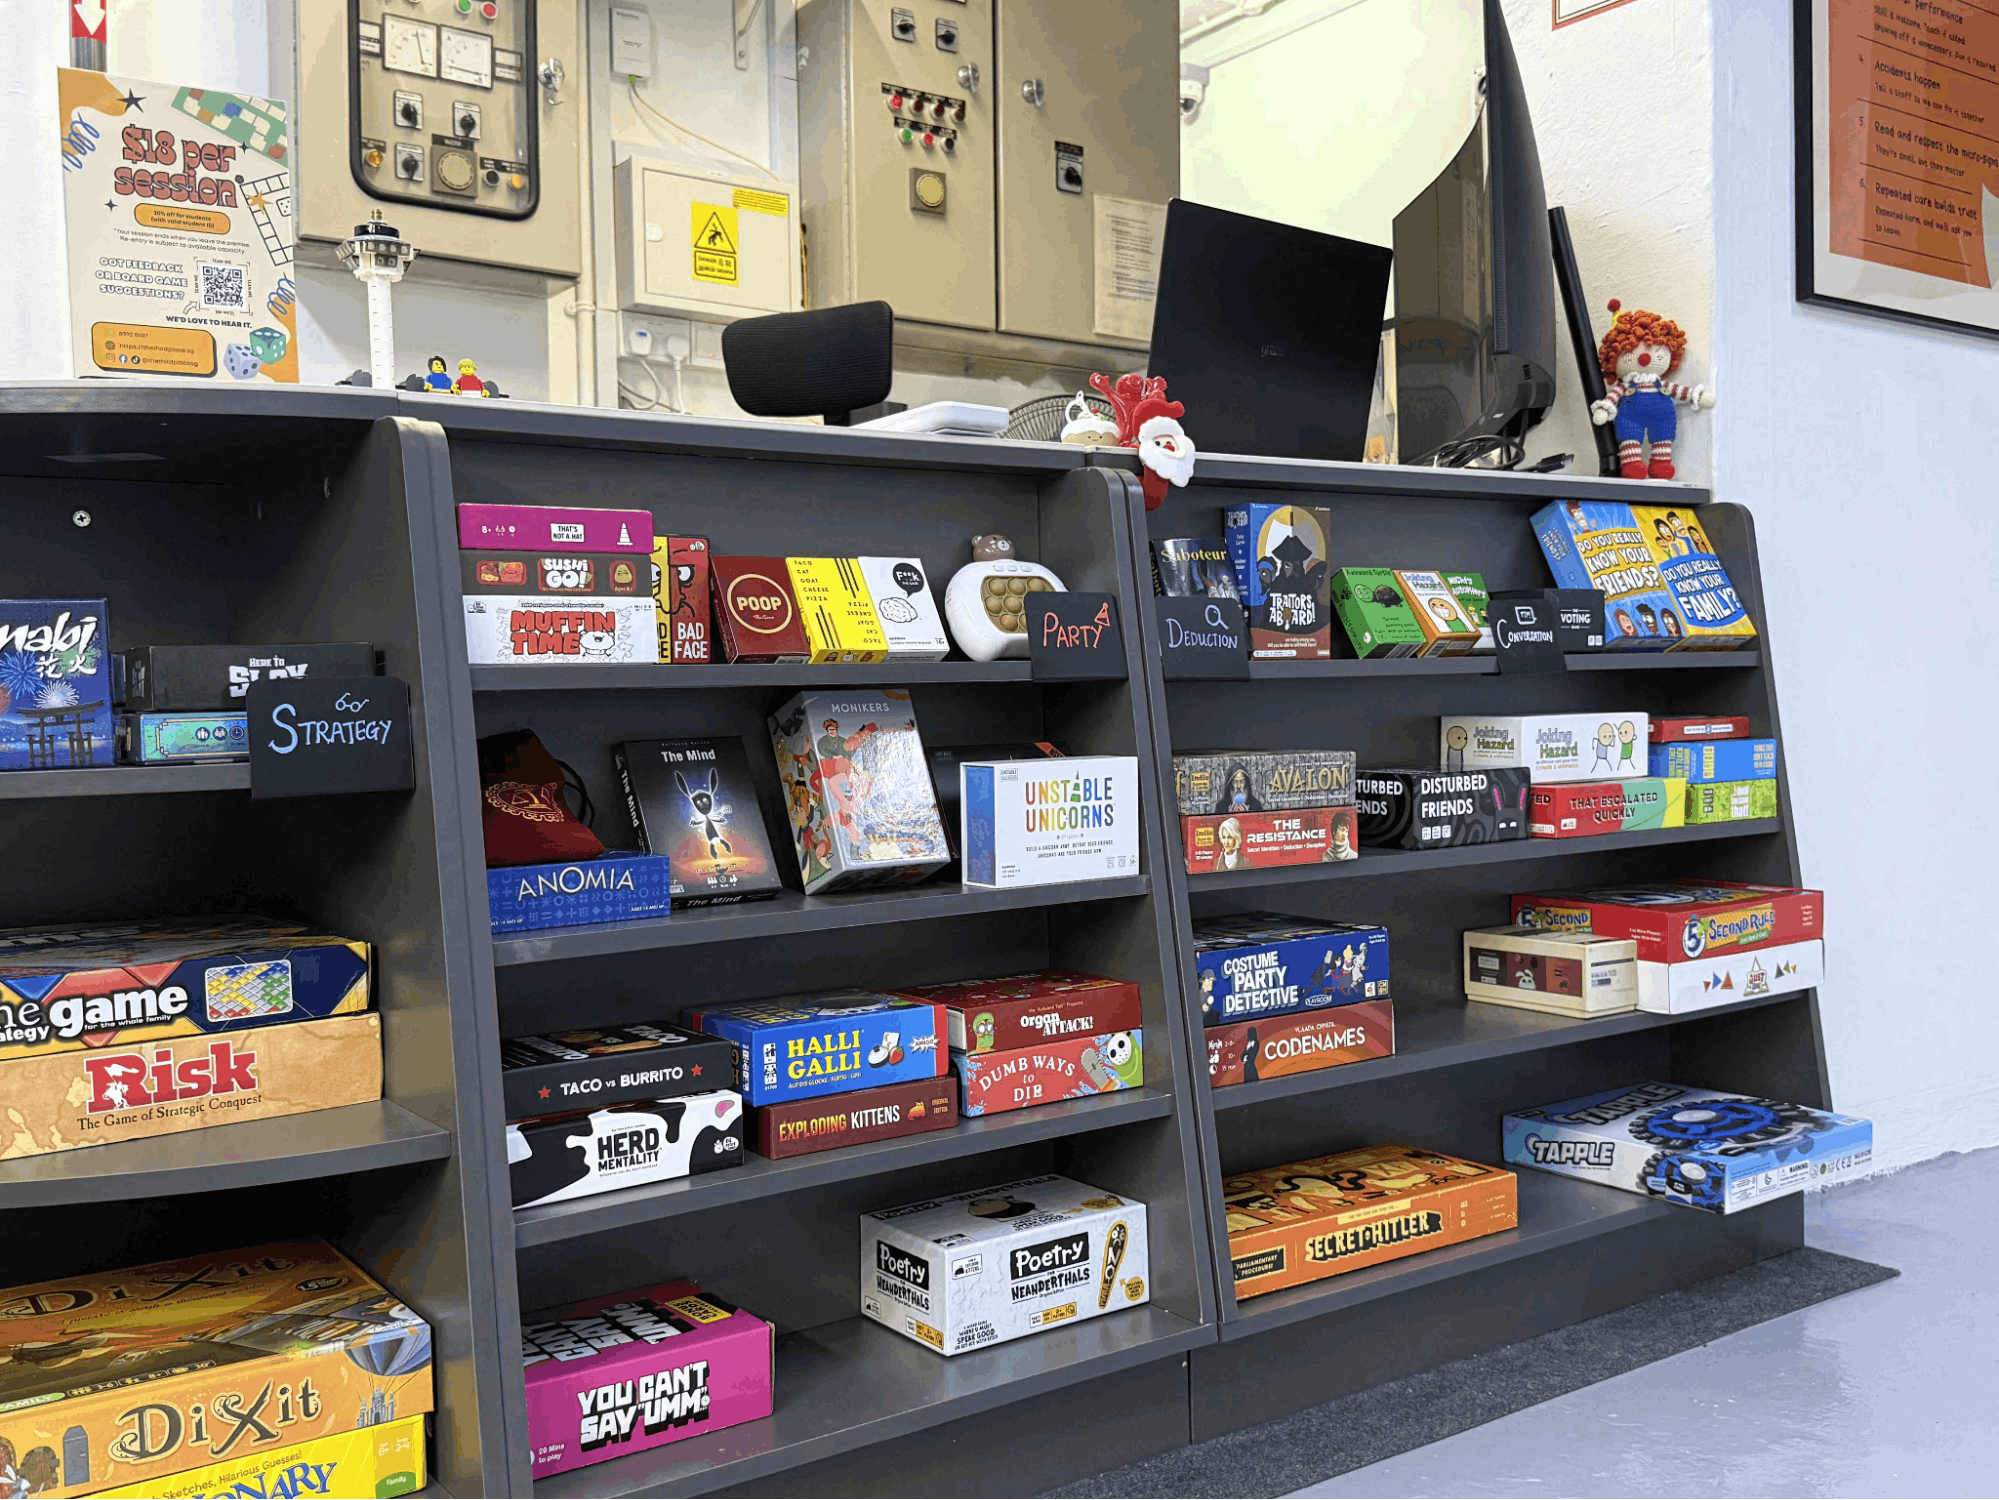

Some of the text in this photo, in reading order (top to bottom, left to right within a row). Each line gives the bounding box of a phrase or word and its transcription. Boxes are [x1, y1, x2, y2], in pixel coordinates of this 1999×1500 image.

[1916, 0, 1964, 24] performance
[1875, 60, 1941, 90] Accidents happen
[122, 123, 236, 173] $18 per
[1875, 121, 1894, 138] Read
[1897, 131, 1912, 142] and
[1914, 135, 1943, 152] respect
[1947, 144, 1959, 156] the
[1876, 145, 1897, 158] They're
[1930, 159, 1943, 171] they
[1945, 164, 1965, 176] matter
[114, 166, 238, 208] session
[1876, 183, 1977, 220] Repeated care builds trust
[99, 257, 183, 273] GOT FEEDBACK
[95, 270, 188, 287] OR BOARD GAME
[100, 284, 185, 300] SUGGESTIONS?
[222, 320, 241, 328] HEAR
[558, 525, 578, 533] THAT'S
[1160, 548, 1227, 562] Saboteur
[1577, 532, 1644, 553] DO YOU REALLY
[1584, 547, 1653, 574] KNOW YOUR
[1663, 559, 1722, 582] DO YOU REALLY
[546, 571, 587, 588] GO!
[1594, 566, 1660, 599] FRIENDS?
[1675, 573, 1724, 594] KNOW YOUR
[737, 596, 782, 611] POOP
[1270, 593, 1312, 609] TRAITORS
[1678, 587, 1740, 622] FAMILY?
[511, 610, 616, 632] MUFFIN
[1043, 612, 1103, 648] PARTY
[1560, 614, 1591, 623] VOTING
[511, 632, 581, 655] TIME
[678, 623, 704, 640] BAD
[1165, 618, 1238, 649] DEDUCTION
[1497, 619, 1552, 649] CONVERSATION
[249, 657, 272, 668] HERE
[674, 641, 708, 660] FACE
[831, 703, 890, 713] MONIKERS
[269, 703, 392, 755] STRATEGY
[1473, 726, 1508, 739] Joking
[1535, 728, 1572, 745] Joking
[661, 749, 716, 763] The Mind
[1477, 739, 1515, 750] Hazard
[1540, 742, 1578, 758] Hazard
[1026, 770, 1112, 805] UNSTABLE
[1269, 764, 1348, 793] AVALON
[1421, 775, 1488, 795] DISTURBED
[621, 770, 639, 828] The Mind
[1421, 798, 1473, 818] FRIENDS
[1570, 792, 1658, 810] THAT ESCALATED
[1026, 804, 1113, 833] UNICORNS
[1273, 819, 1301, 830] THE
[1593, 807, 1636, 823] QUICKLY
[1247, 829, 1327, 844] RESISTANCE
[518, 866, 635, 901] ANOMIA
[1686, 921, 1701, 952] 5
[1224, 951, 1278, 975] COSTUME
[1234, 966, 1288, 992] PARTY
[1749, 972, 1765, 984] JUST
[49, 984, 189, 1038] game
[1226, 985, 1299, 1013] DETECTIVE
[84, 1013, 172, 1030] for the whole family
[1020, 1012, 1093, 1037] Organ ATTACK!
[787, 1030, 860, 1058] HALLI
[1264, 1026, 1365, 1060] CODENAMES
[83, 1041, 257, 1115] Risk
[787, 1051, 862, 1080] GALLI
[979, 1054, 1075, 1092] DUMB WAYS
[560, 1078, 602, 1096] TACO
[620, 1067, 683, 1087] BURRITO
[1023, 1074, 1035, 1084] to
[1013, 1084, 1042, 1101] DIE
[1572, 1083, 1686, 1126] TAPPLE
[77, 1093, 263, 1131] The Game of Strategic Conquest
[780, 1105, 900, 1142] EXPLODING KITTENS
[597, 1128, 660, 1160] HERD
[1533, 1140, 1615, 1166] TAPPLE
[598, 1150, 660, 1172] MENTALITY
[1305, 1211, 1429, 1260] SECRET HITLER
[880, 1243, 925, 1283] Poetry
[1015, 1241, 1083, 1276] Poetry
[1236, 1254, 1278, 1270] PARLIAMENTARY
[876, 1275, 929, 1311] NEANDERTHALS
[1011, 1268, 1090, 1300] NEANDERTHALS
[957, 1329, 995, 1344] SPEAK GOOD
[577, 1360, 708, 1416] YOU CAN'T
[580, 1404, 638, 1445] SAY
[547, 1452, 562, 1462] play
[162, 1449, 302, 1500] Sketches, Hilarious Guesses!
